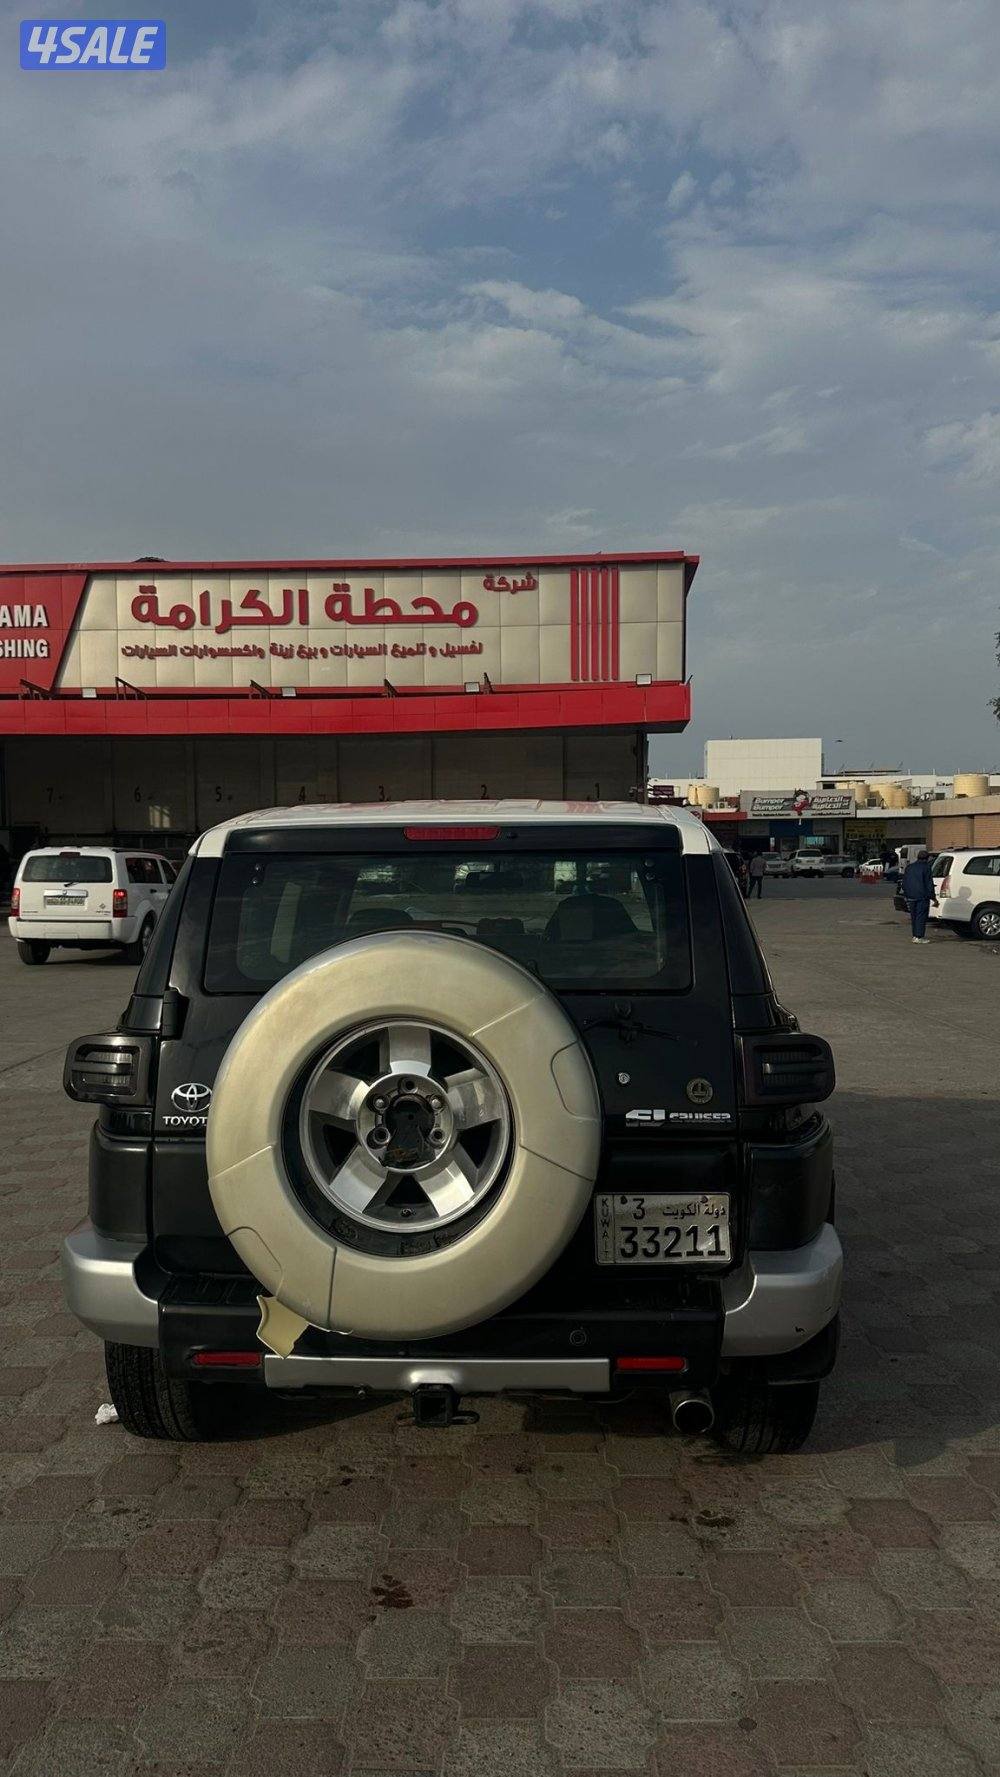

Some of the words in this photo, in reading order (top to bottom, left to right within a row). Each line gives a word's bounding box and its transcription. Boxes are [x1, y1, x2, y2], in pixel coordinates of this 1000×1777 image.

[483, 571, 539, 594] شركة
[131, 584, 309, 634] الكرامة
[325, 582, 479, 628] محطة
[121, 644, 178, 659] السيارات
[329, 643, 388, 659] السيارات
[391, 642, 427, 658] تلميع
[215, 786, 222, 802] 5
[162, 1116, 208, 1127] TOYOT
[632, 1198, 646, 1220] 3
[662, 1202, 700, 1220] الكويت
[703, 1202, 727, 1219] دولة
[620, 1224, 726, 1258] 33211
